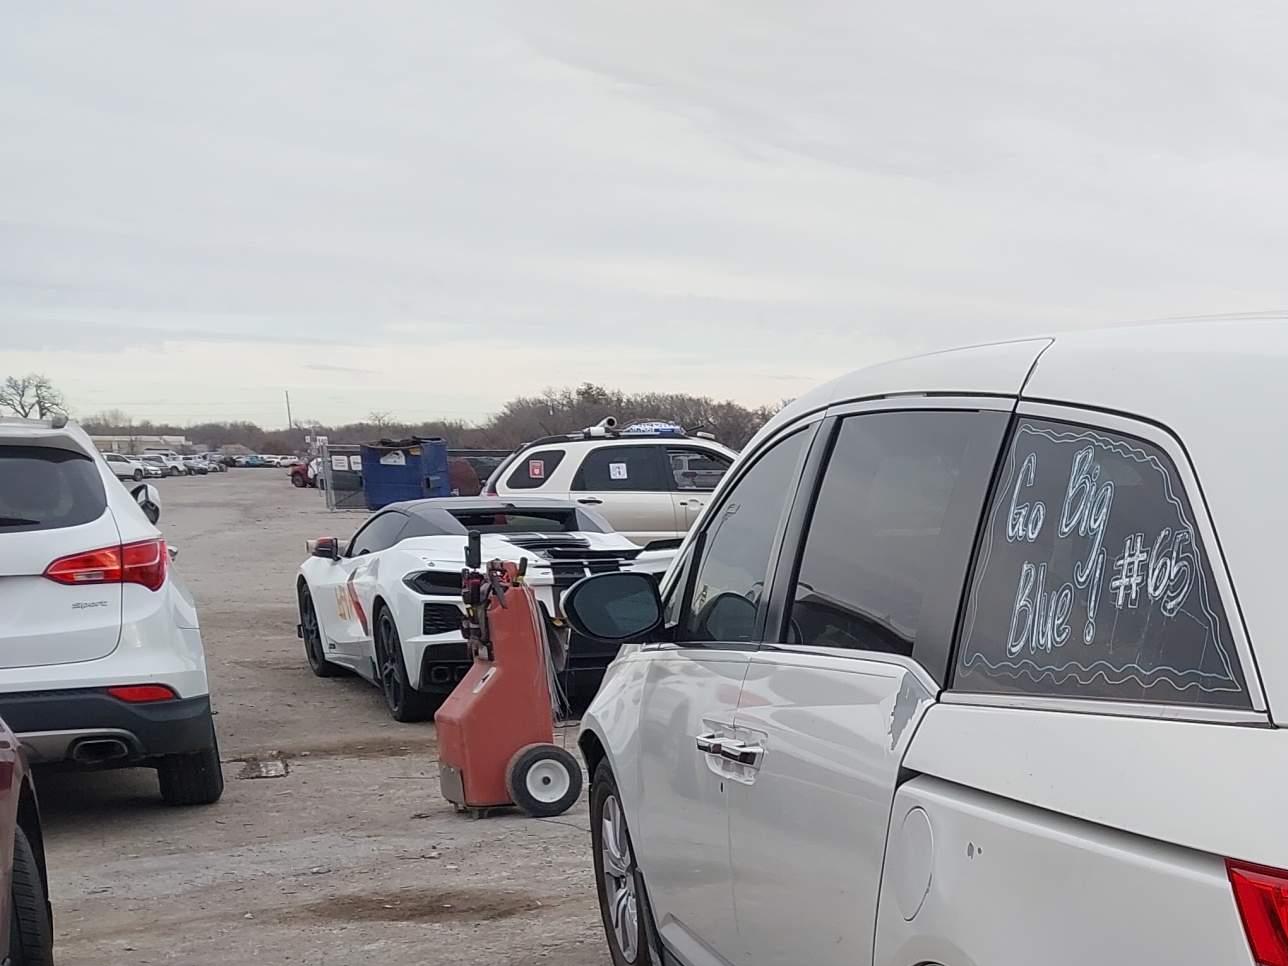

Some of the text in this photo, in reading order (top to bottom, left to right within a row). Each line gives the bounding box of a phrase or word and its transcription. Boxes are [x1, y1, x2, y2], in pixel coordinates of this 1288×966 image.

[1007, 446, 1114, 588] Go Big
[1110, 528, 1196, 616] #65
